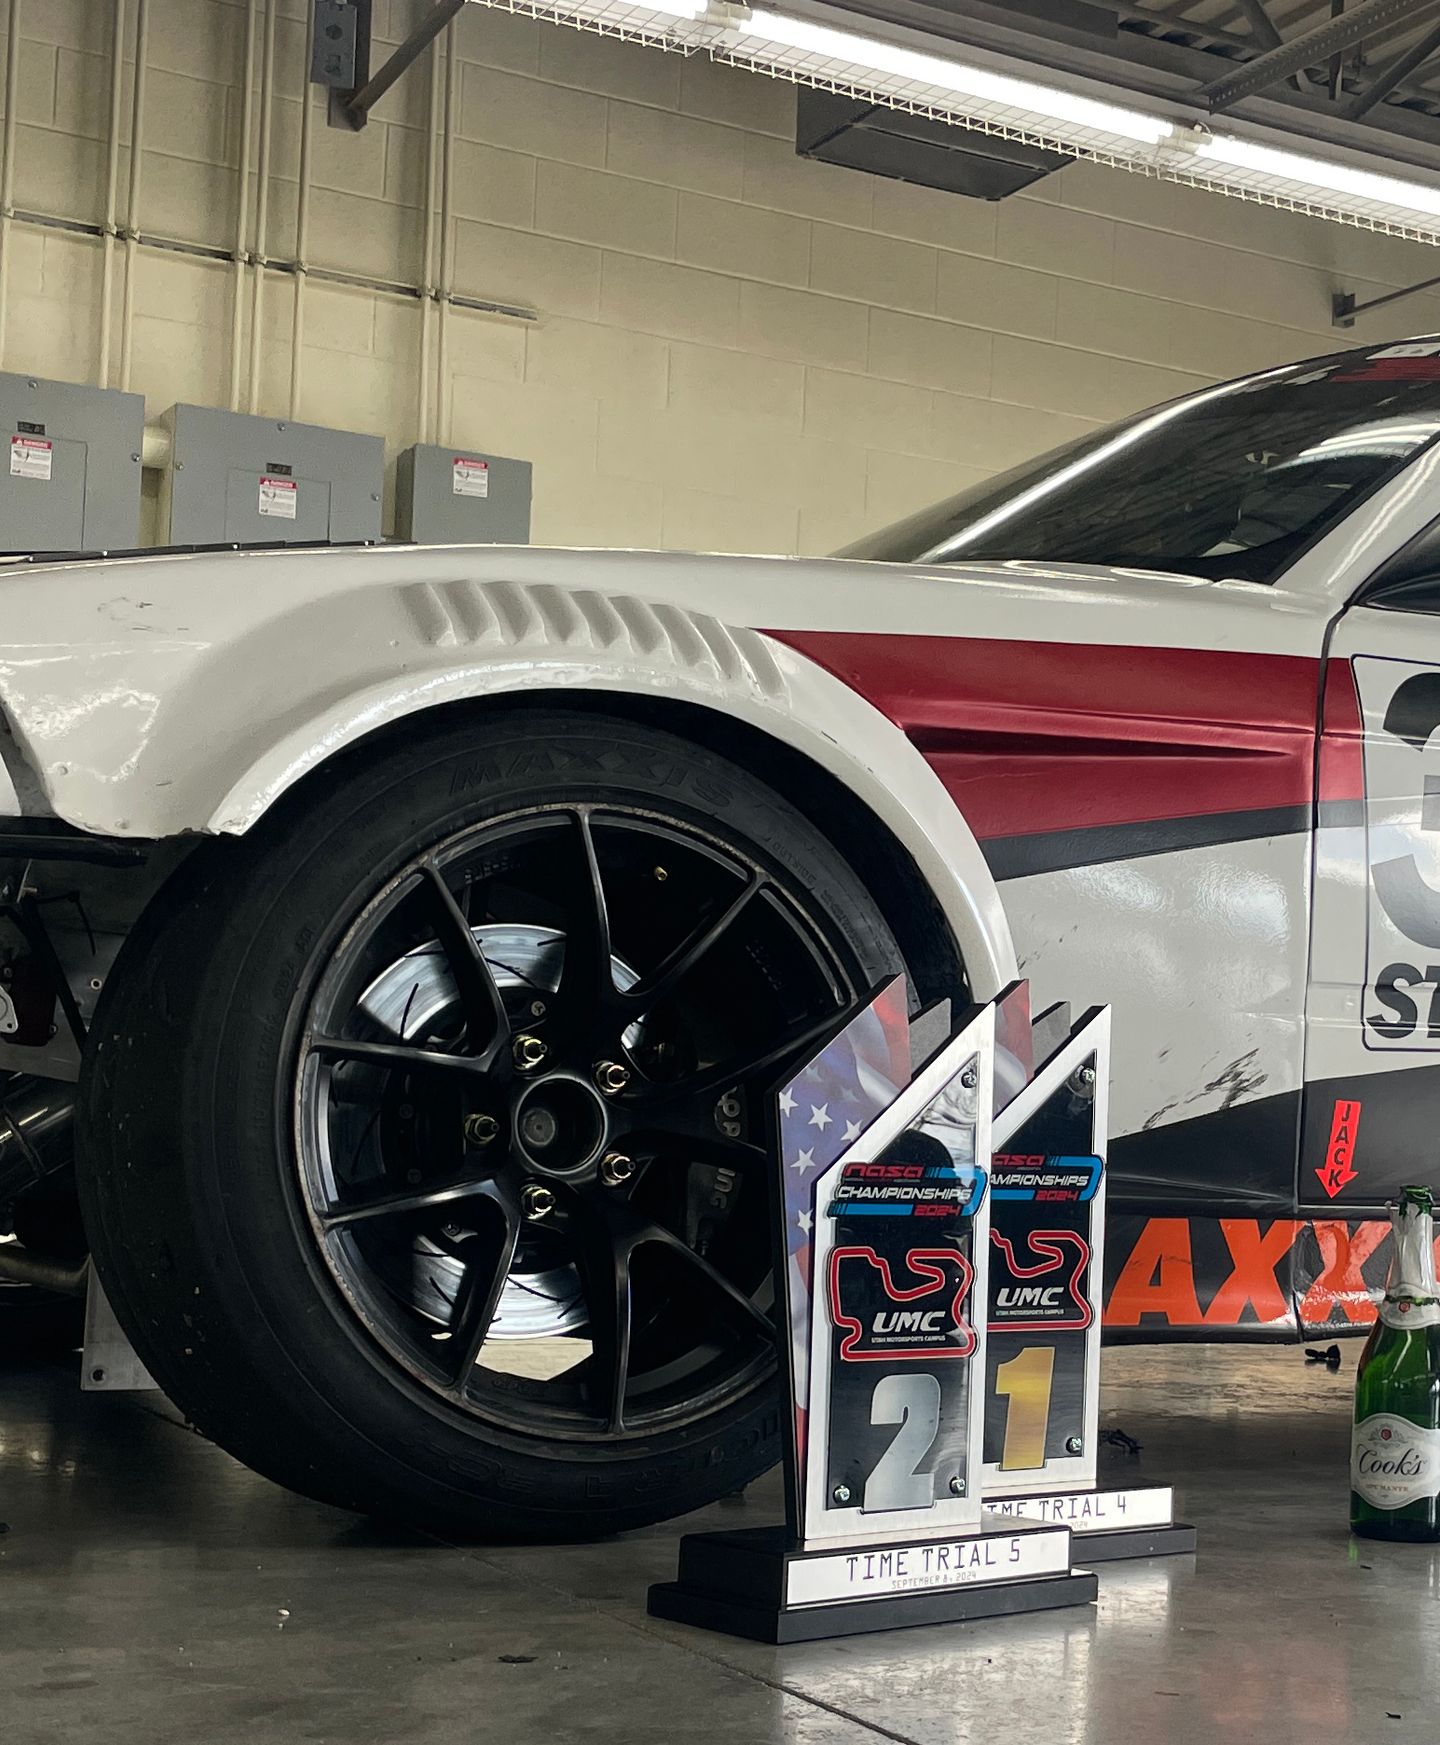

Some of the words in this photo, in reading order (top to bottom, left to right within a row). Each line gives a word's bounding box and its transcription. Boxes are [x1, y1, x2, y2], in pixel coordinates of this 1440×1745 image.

[1329, 1103, 1351, 1187] JACK
[991, 1154, 1045, 1167] asa
[990, 1175, 1089, 1187] AMPIONSHIPS
[838, 1185, 973, 1200] CHAMPIONSHIPS
[1035, 1190, 1078, 1201] 2024
[913, 1204, 962, 1217] 2024
[997, 1287, 1064, 1307] UMC
[872, 1311, 946, 1333] UMC
[995, 1346, 1056, 1471] 1
[862, 1373, 942, 1515] 2
[1356, 1444, 1424, 1476] Cook's
[1039, 1497, 1106, 1521] TRIAL
[1117, 1495, 1127, 1514] 4
[846, 1550, 909, 1582] TIME
[922, 1541, 996, 1572] TRIAL
[1009, 1538, 1020, 1562] 5
[956, 1571, 977, 1581] 2024
